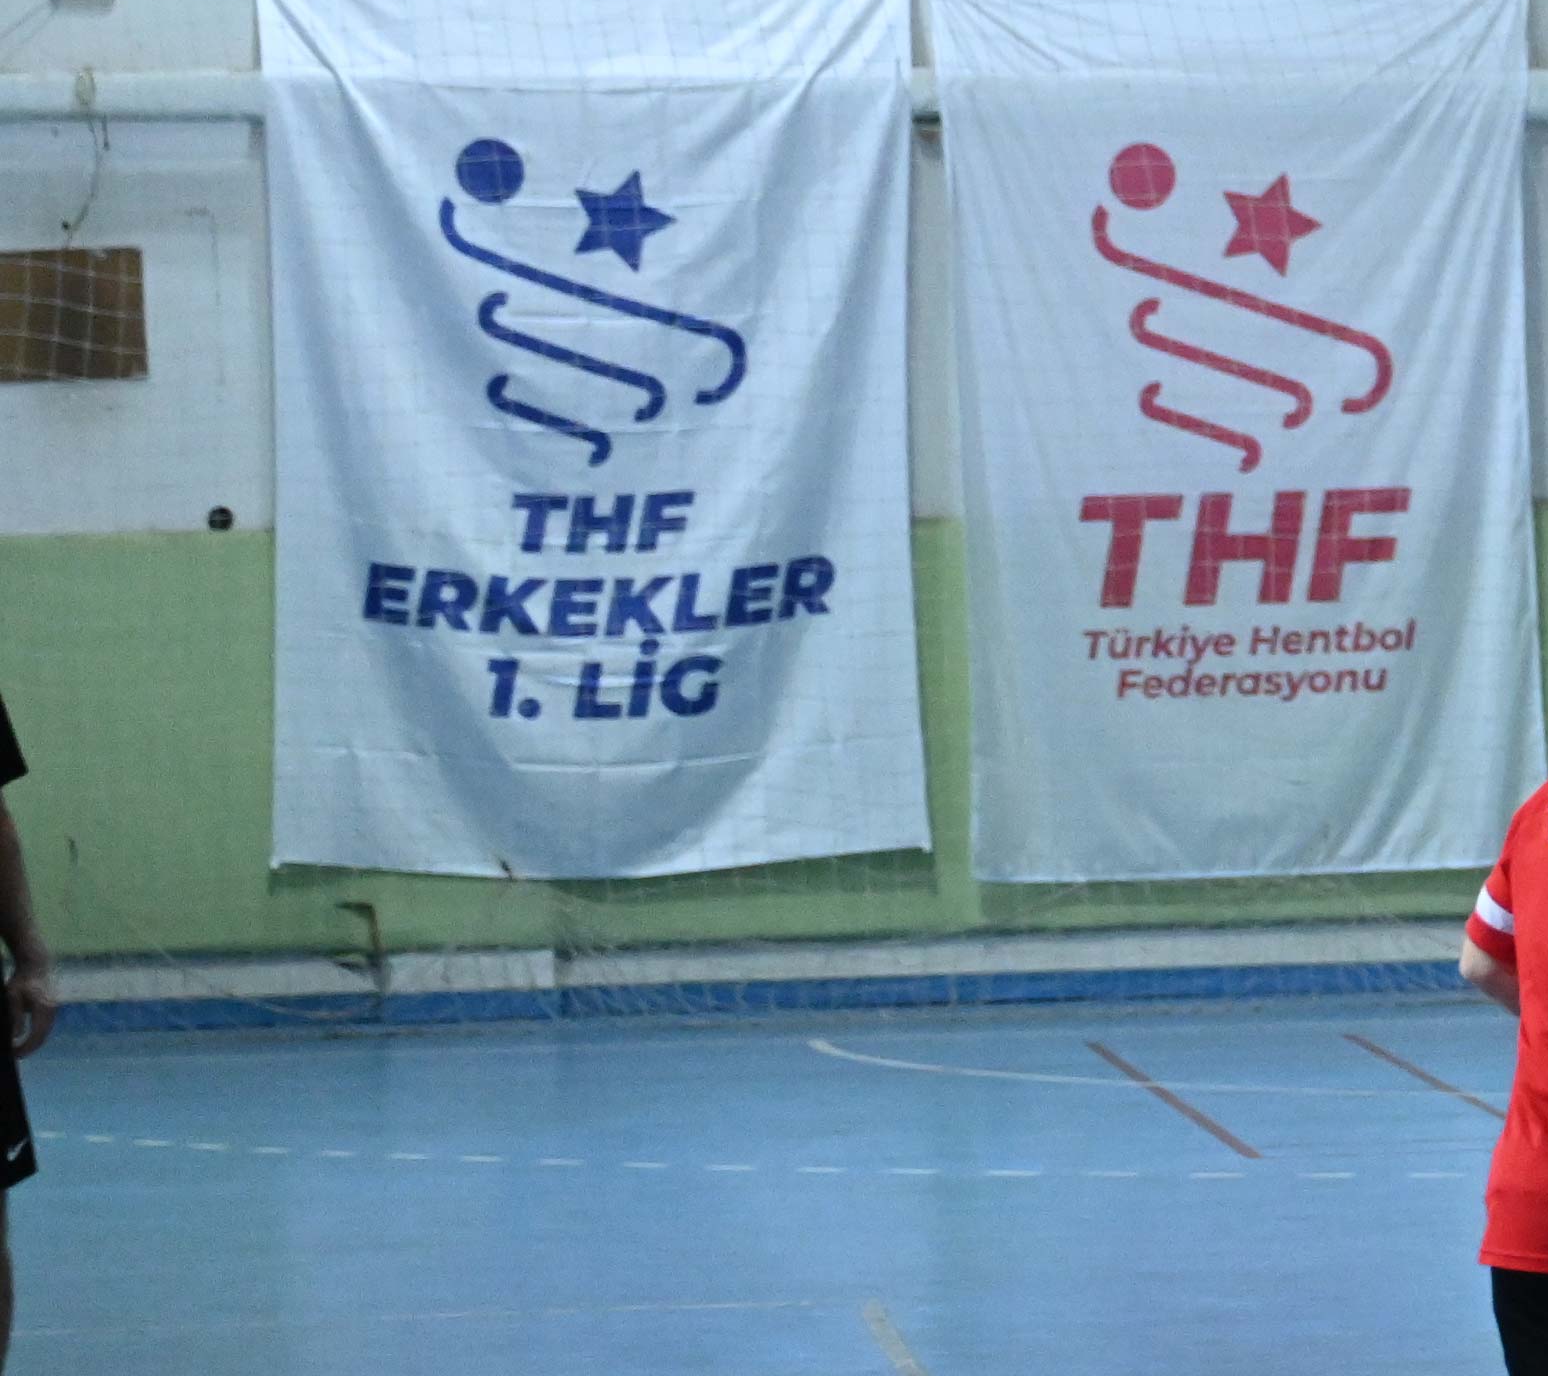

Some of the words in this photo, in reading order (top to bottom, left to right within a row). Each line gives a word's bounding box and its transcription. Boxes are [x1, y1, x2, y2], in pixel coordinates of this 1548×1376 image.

[511, 490, 695, 554] THF
[1078, 486, 1413, 609] THF
[362, 555, 836, 638] ERKEKLER
[1084, 624, 1236, 665] Türkiye
[1249, 618, 1416, 659] Hentbol
[487, 657, 541, 720] 1.
[572, 638, 725, 721] LİG
[1116, 665, 1388, 702] Federasyonu
